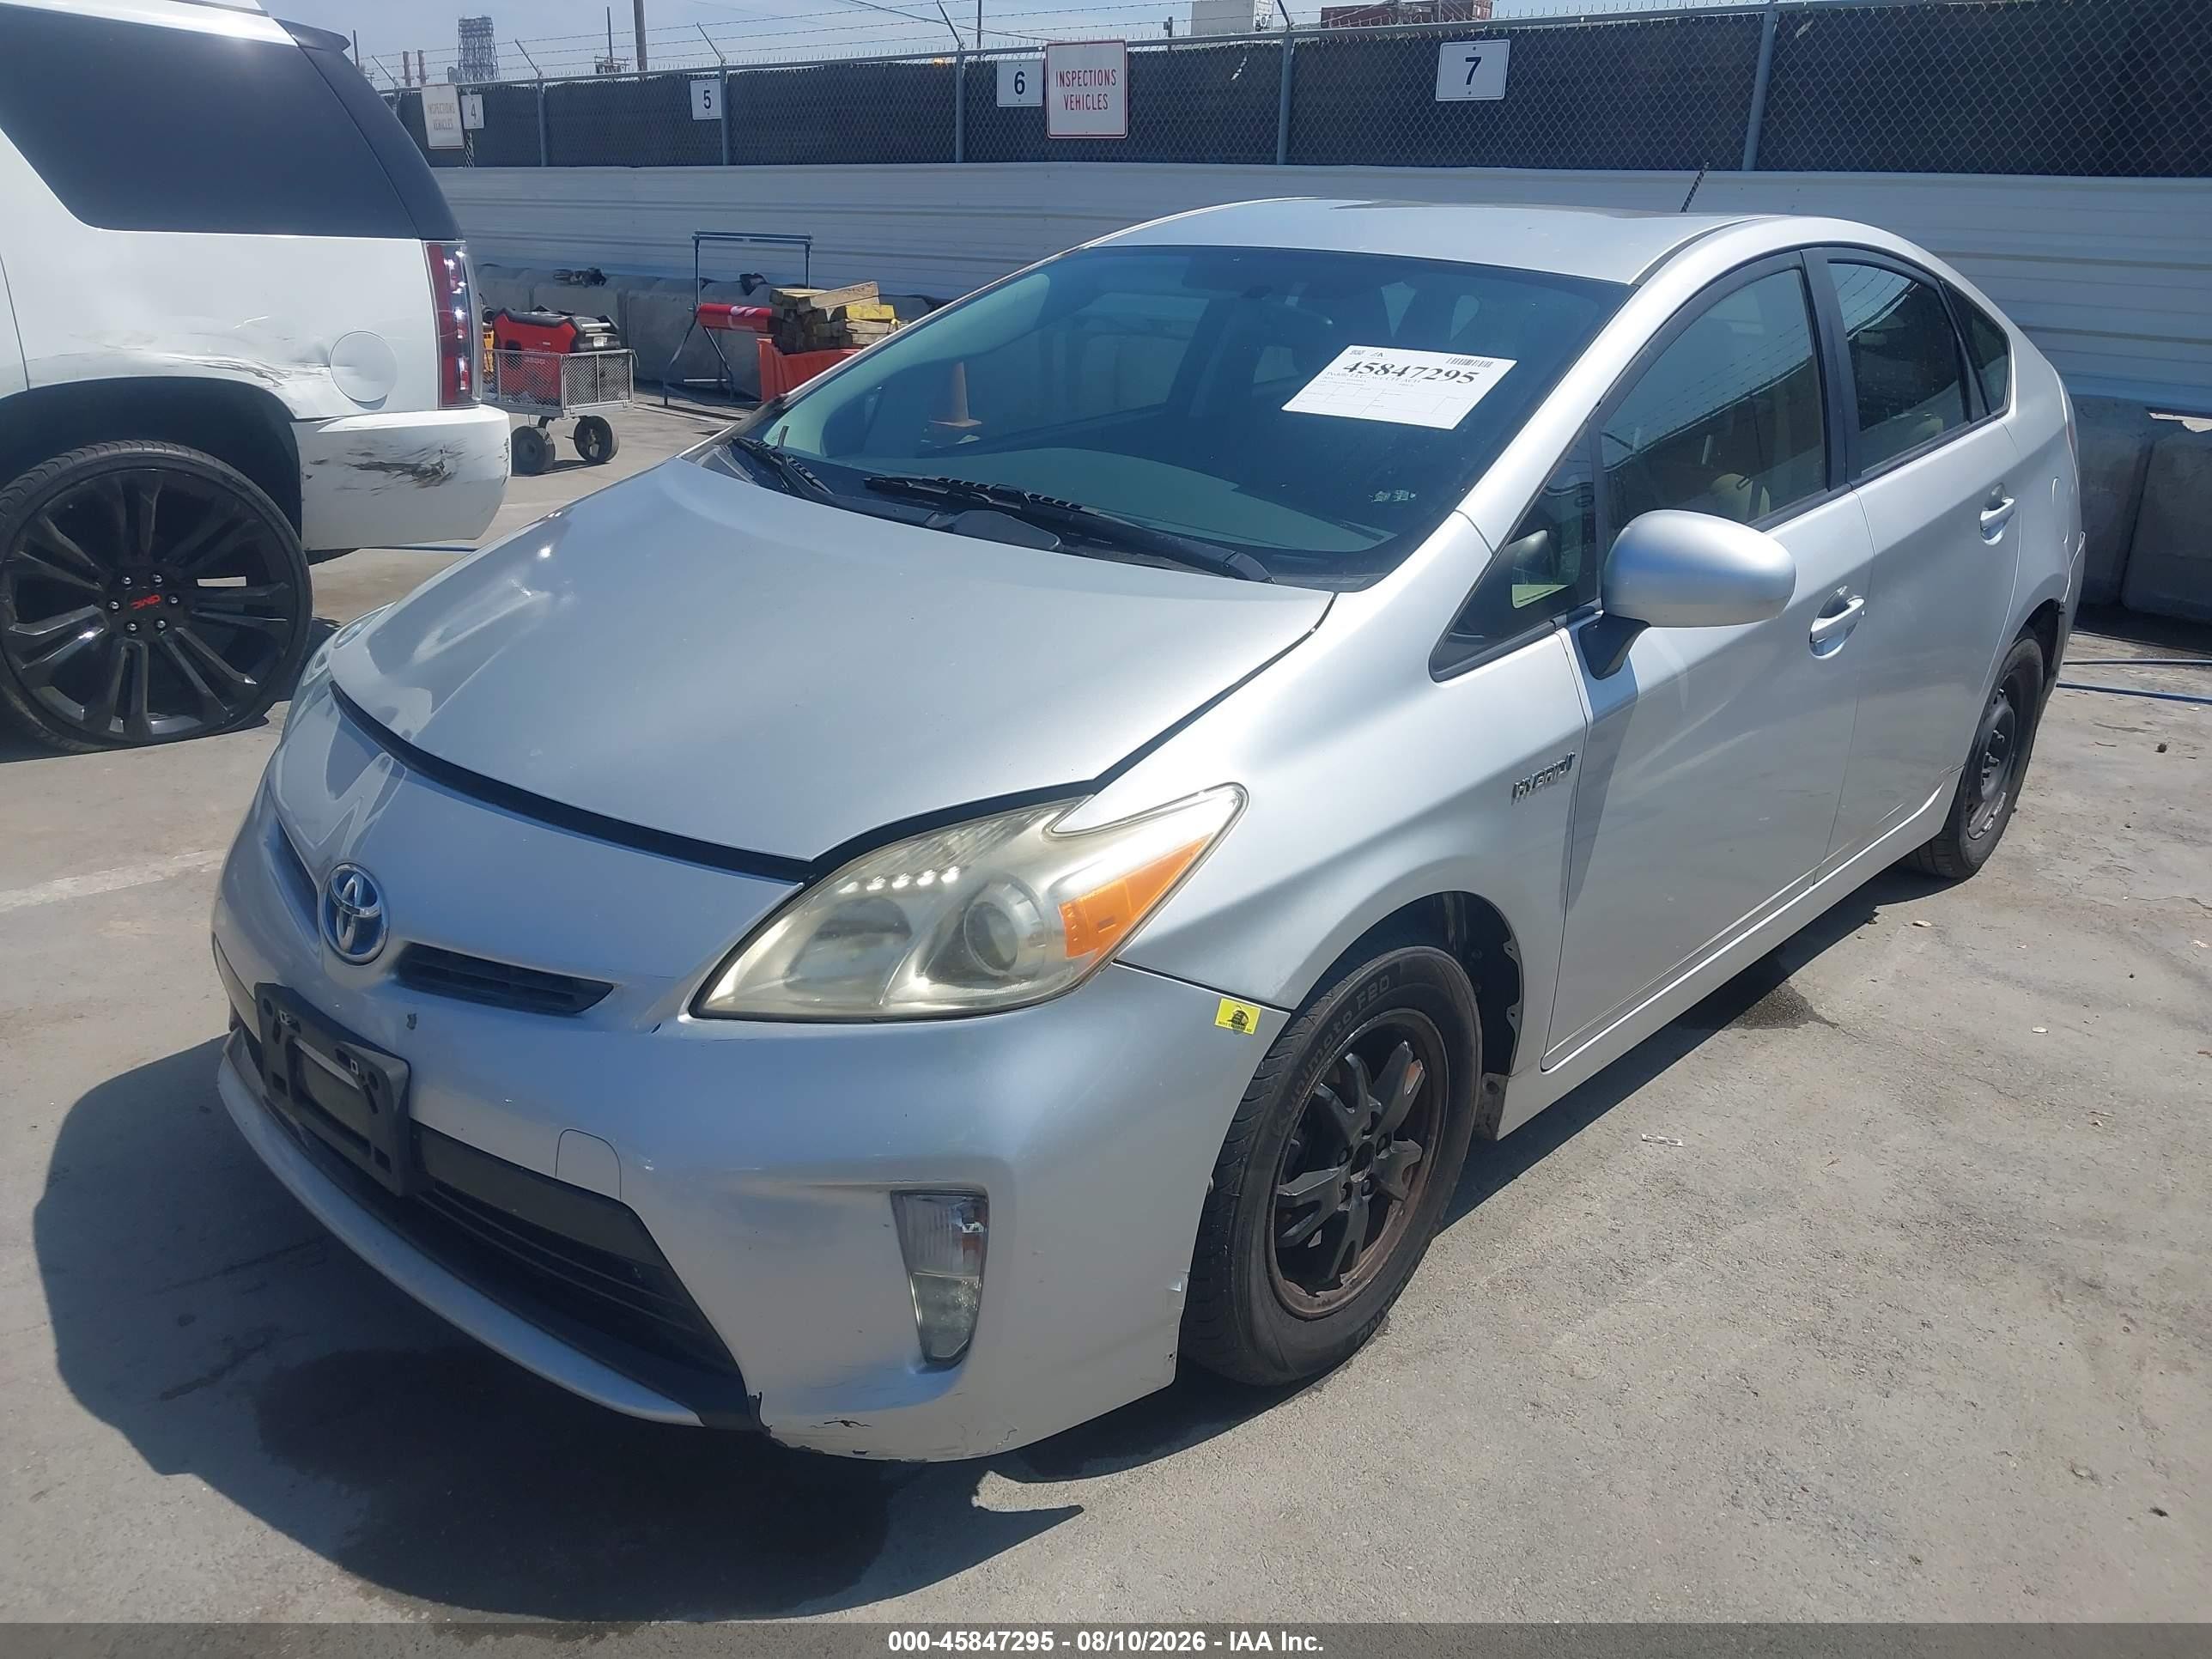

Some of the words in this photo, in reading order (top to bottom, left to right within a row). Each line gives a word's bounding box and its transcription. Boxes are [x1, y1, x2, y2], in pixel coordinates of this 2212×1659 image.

[1055, 68, 1117, 88] INSPECTIONS
[1464, 57, 1483, 86] 7
[1013, 71, 1025, 95] 6
[702, 89, 712, 110] 5
[1063, 93, 1109, 112] VEHICLES
[471, 103, 477, 120] 4
[1342, 361, 1480, 384] 45847295
[1515, 757, 1568, 795] HYBRID
